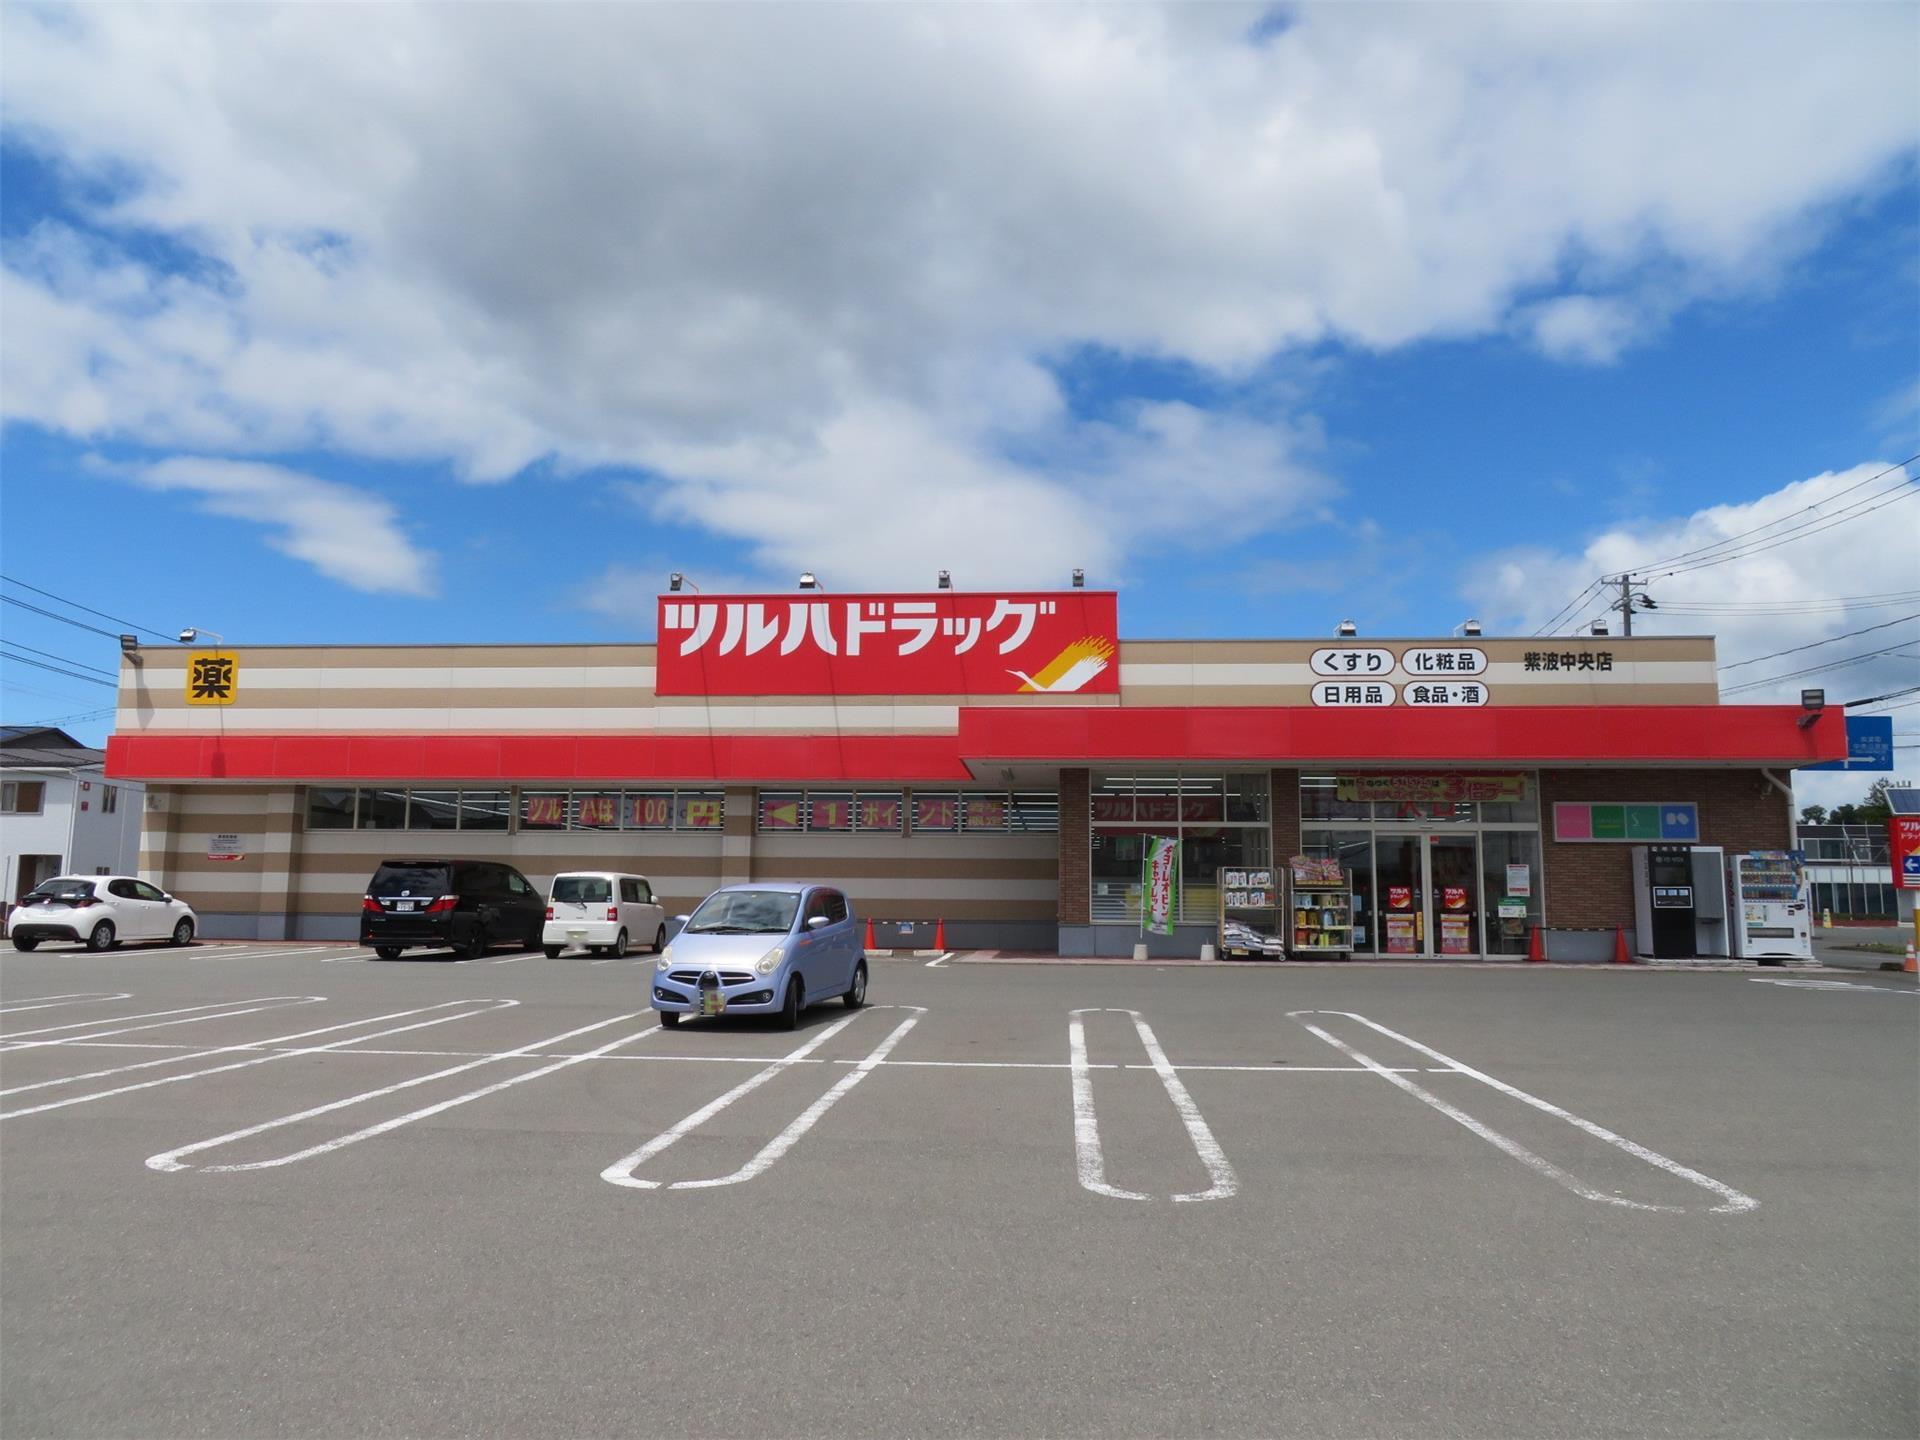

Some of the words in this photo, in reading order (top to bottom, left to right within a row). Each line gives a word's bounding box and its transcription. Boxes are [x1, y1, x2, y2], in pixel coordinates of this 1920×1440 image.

[664, 599, 1057, 657] ツルハドラッグ
[1322, 652, 1383, 673] くすり
[1414, 652, 1476, 672] 化粧品
[1523, 651, 1613, 672] 紫波中央店
[191, 657, 233, 699] 薬
[1324, 685, 1383, 704] 日用品
[1412, 685, 1481, 705] 食品・酒
[1389, 887, 1409, 895] ツルハ
[1444, 887, 1465, 895] ツルハ
